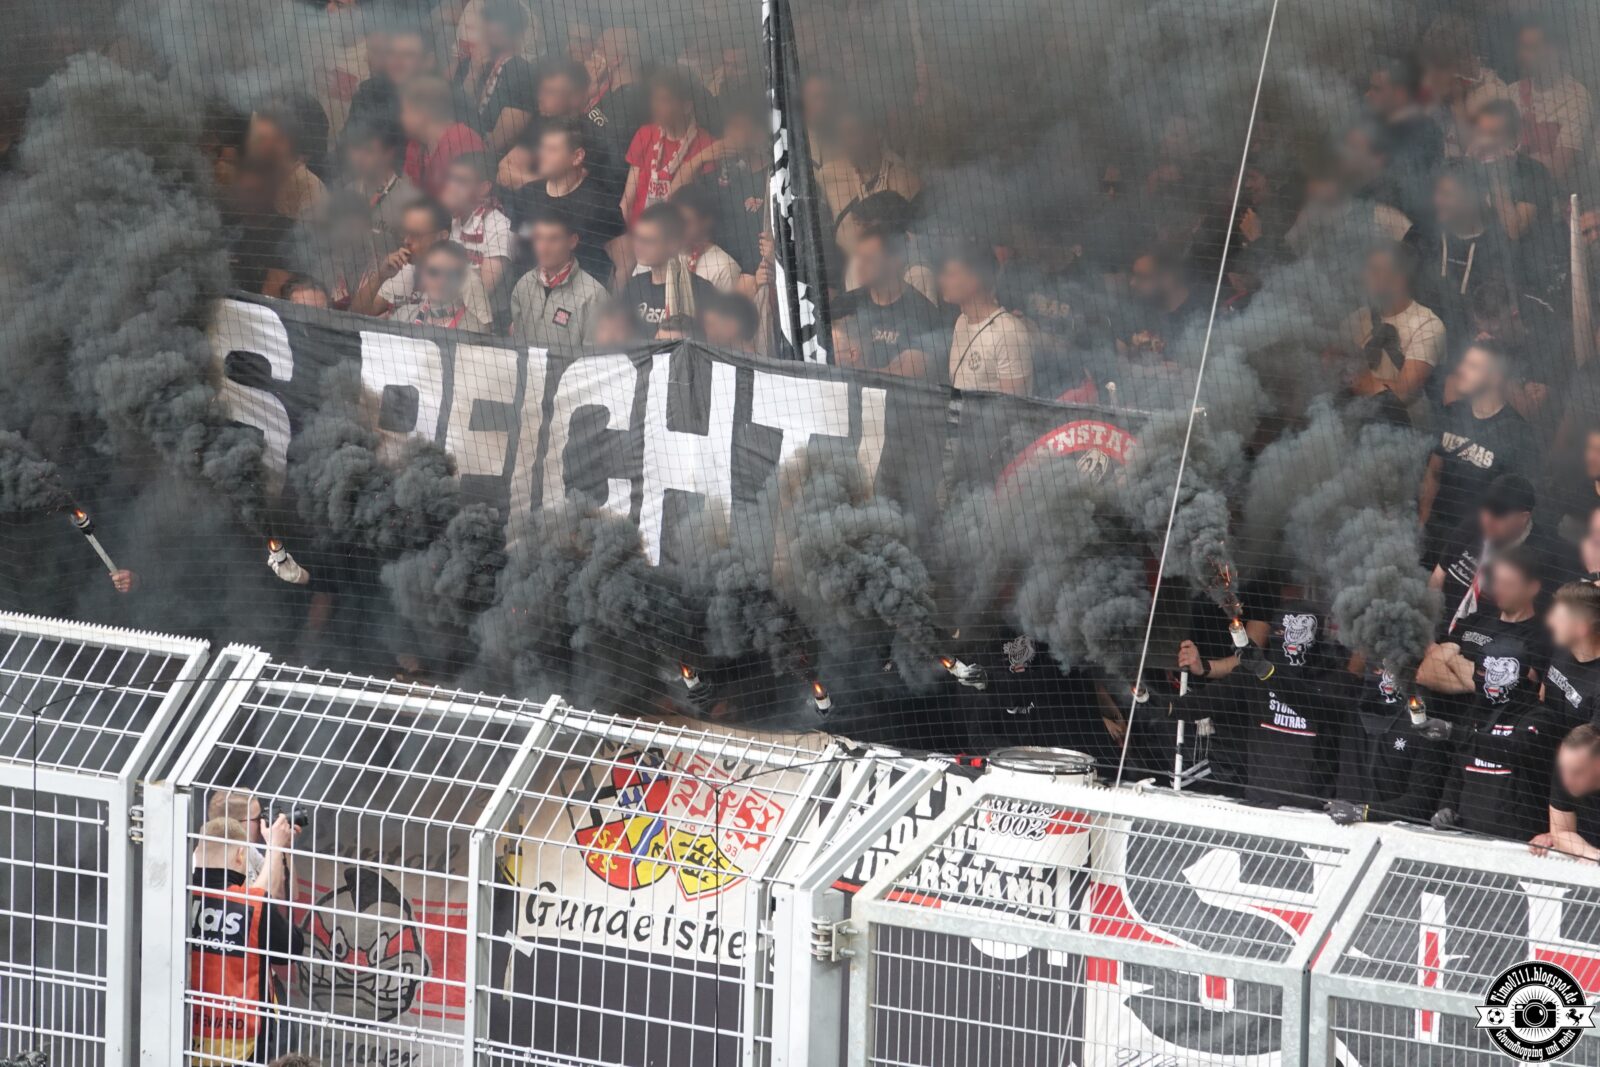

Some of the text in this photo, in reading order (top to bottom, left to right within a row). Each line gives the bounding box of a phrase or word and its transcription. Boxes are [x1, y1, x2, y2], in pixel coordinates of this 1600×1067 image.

[1274, 712, 1307, 729] ULTRAS
[842, 849, 1054, 916] IDRSTAND
[192, 900, 243, 935] las
[526, 881, 747, 960] Gundelshe
[193, 1012, 245, 1031] TEWARD
